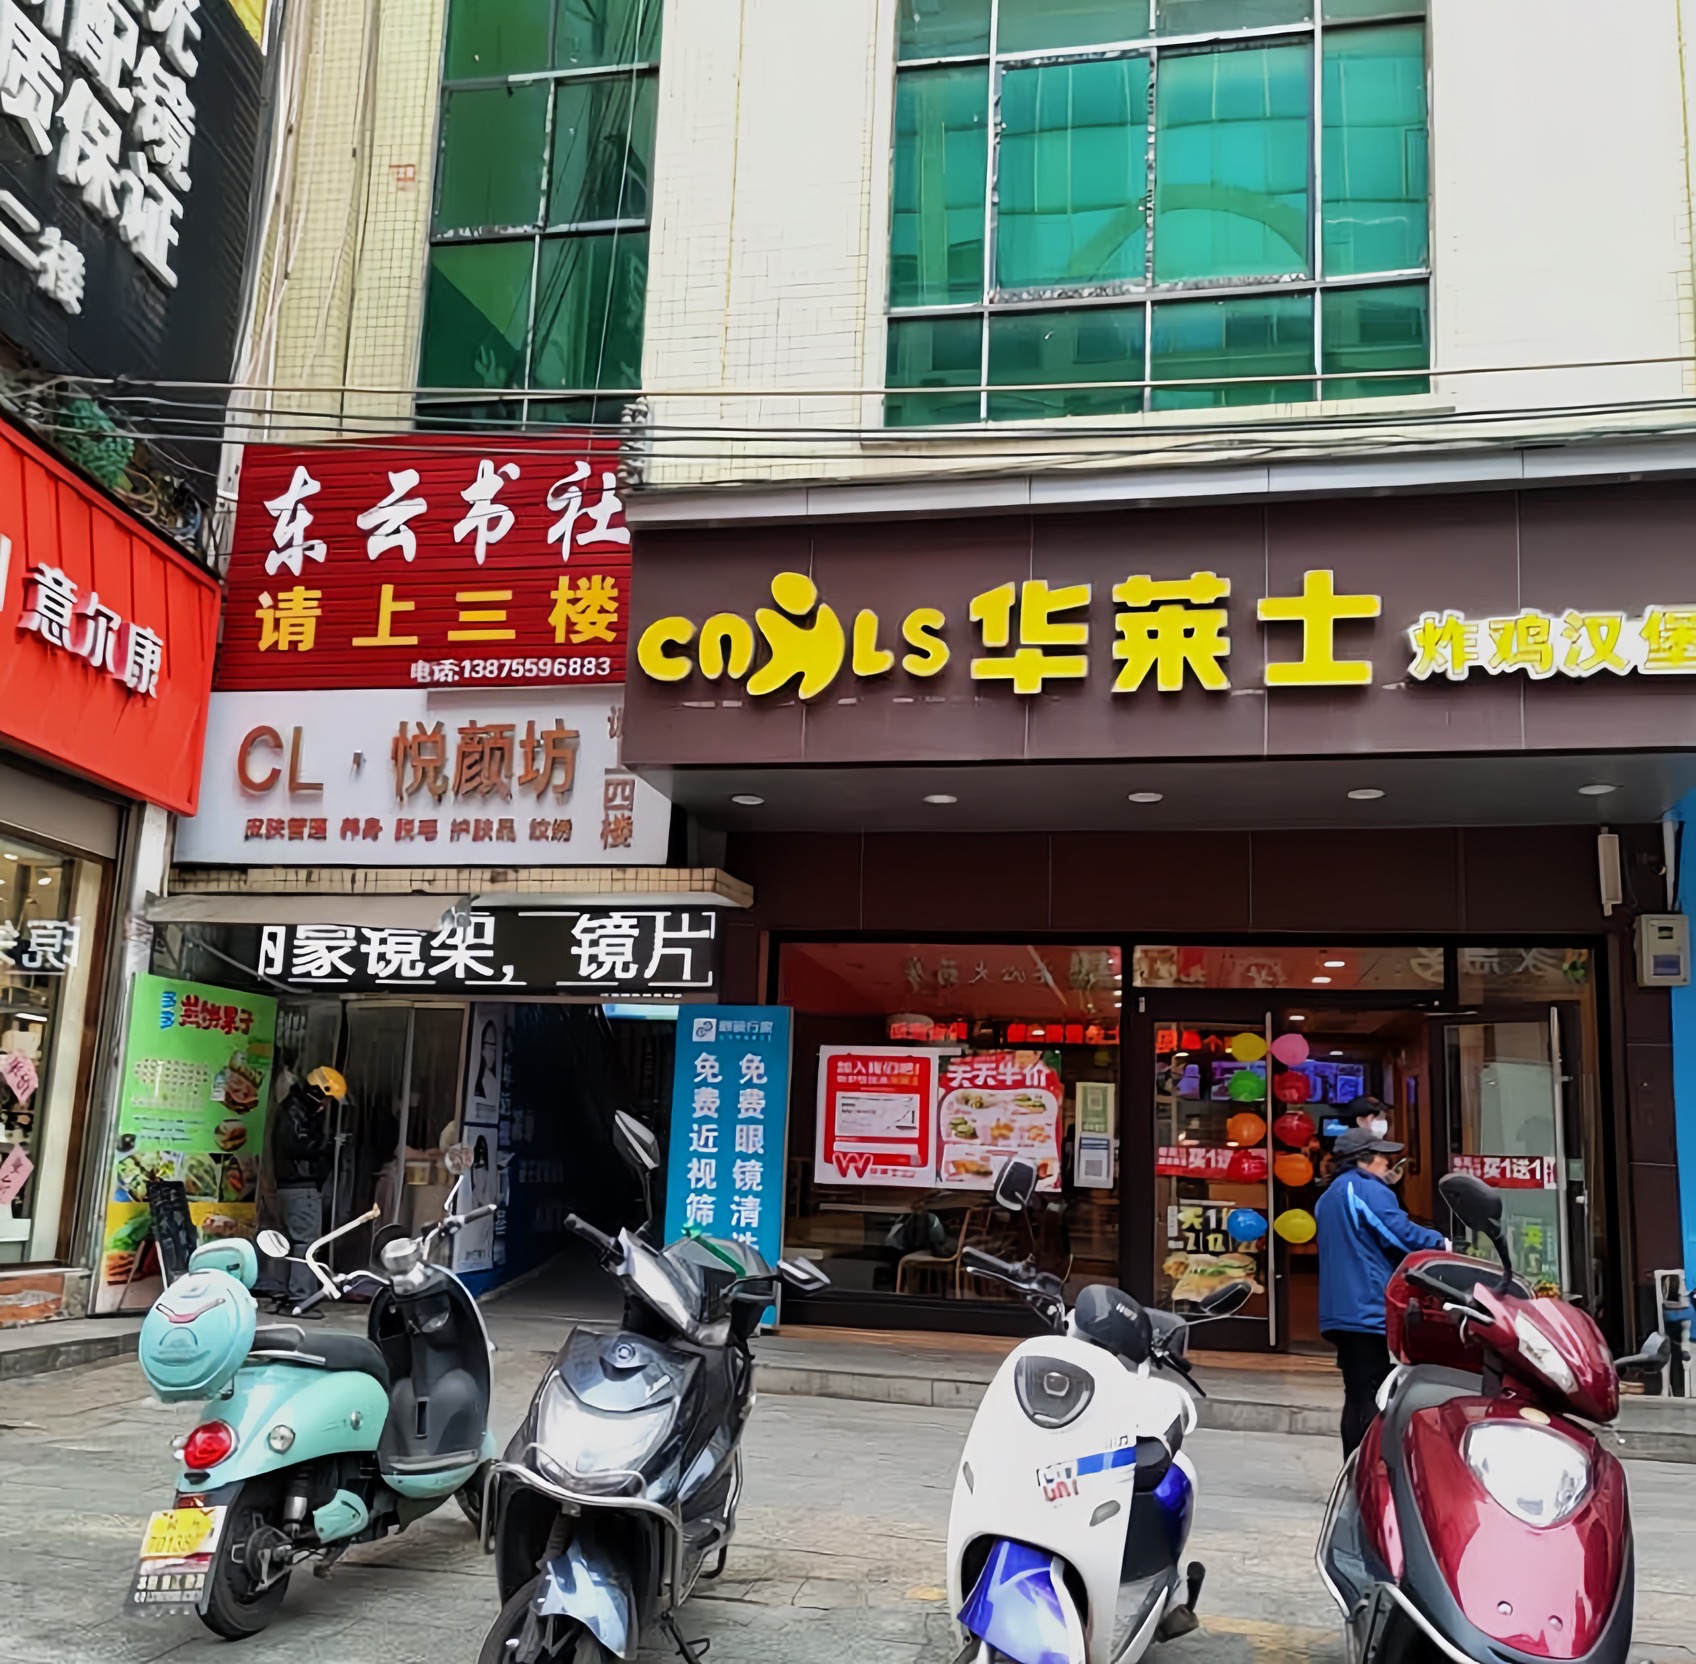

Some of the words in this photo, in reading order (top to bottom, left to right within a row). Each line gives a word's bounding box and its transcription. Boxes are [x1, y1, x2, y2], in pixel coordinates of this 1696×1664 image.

[0, 190, 85, 314] 二楼
[264, 459, 630, 576] 东云书社
[20, 562, 163, 698] 意尔康
[255, 575, 619, 651] 请上三楼
[970, 571, 1381, 693] 华莱士
[1409, 607, 1696, 680] 炸鸡汉堡
[391, 718, 580, 800] 悦颜坊
[685, 1052, 723, 1236] 免费近视筛
